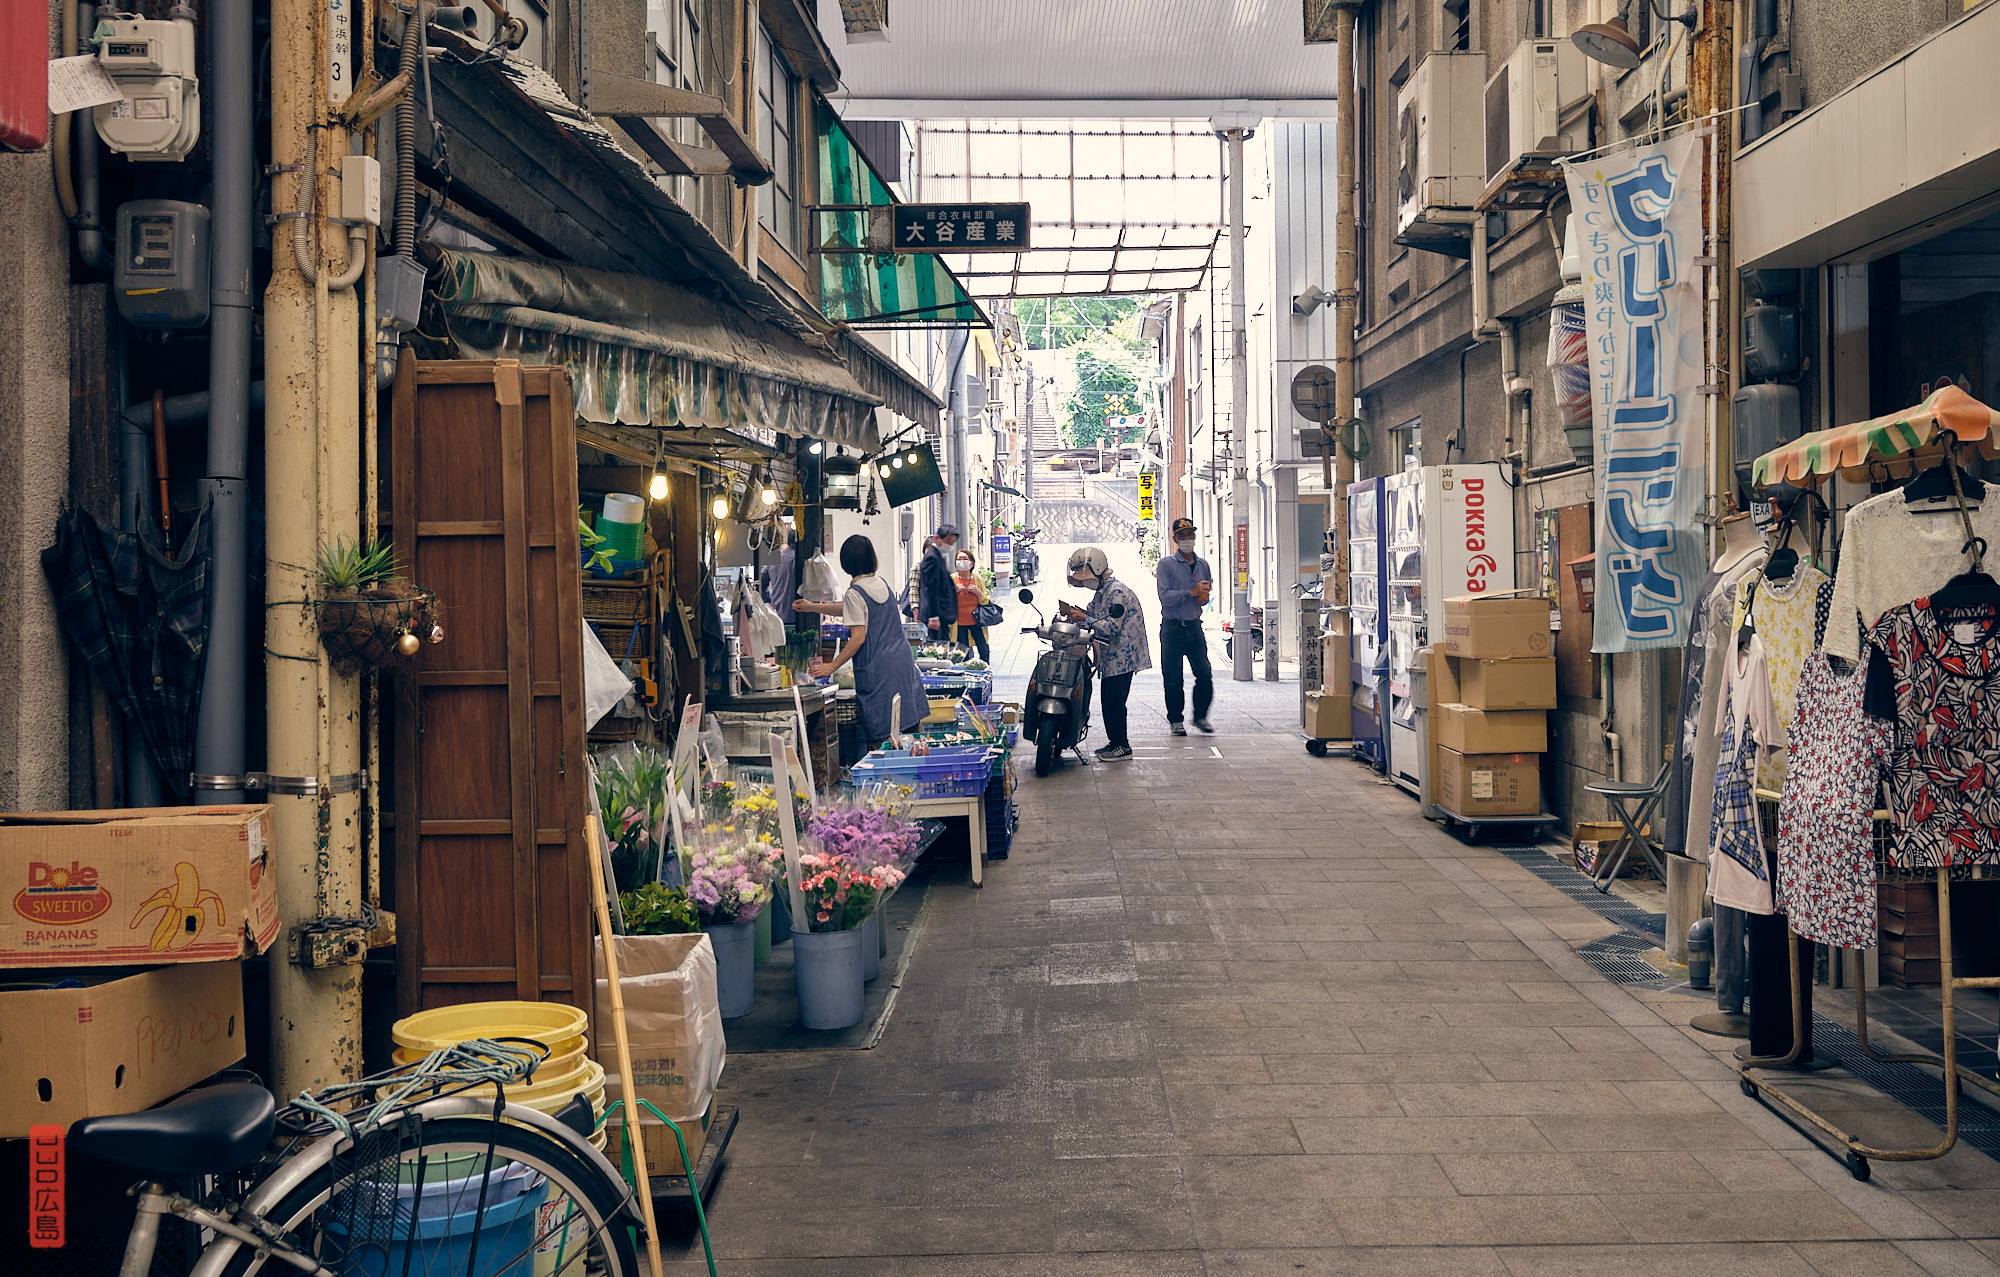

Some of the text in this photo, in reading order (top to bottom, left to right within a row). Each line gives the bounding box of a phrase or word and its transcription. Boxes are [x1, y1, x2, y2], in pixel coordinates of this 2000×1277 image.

[332, 14, 347, 81] 中浜幹 3
[905, 220, 1016, 242] 大谷産業
[1140, 475, 1153, 511] 写真
[1305, 626, 1319, 690] 荒神堂通り
[28, 861, 98, 889] Dole
[32, 900, 94, 913] SWEETIO
[25, 929, 98, 941] BANANAS
